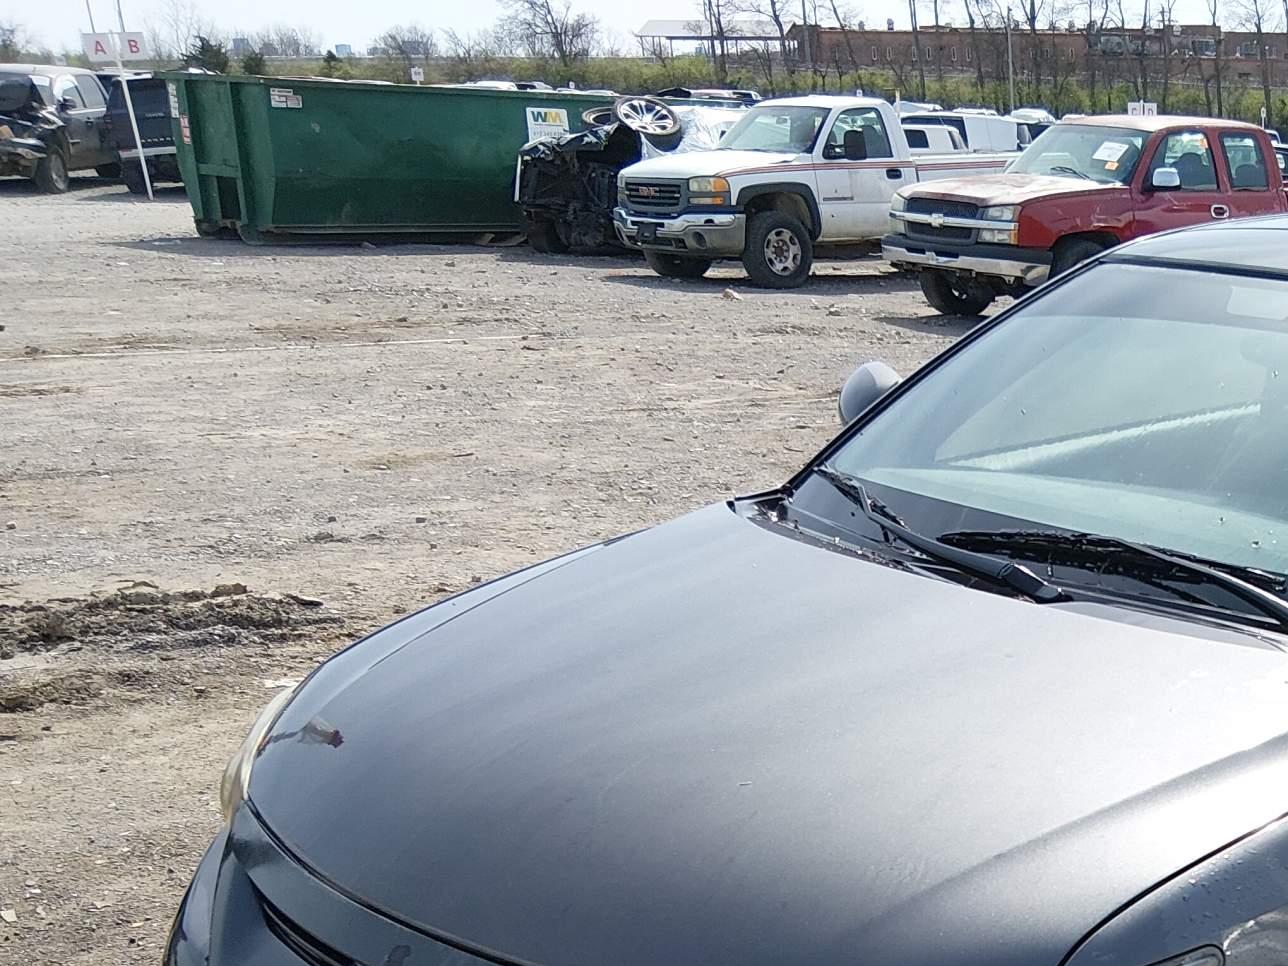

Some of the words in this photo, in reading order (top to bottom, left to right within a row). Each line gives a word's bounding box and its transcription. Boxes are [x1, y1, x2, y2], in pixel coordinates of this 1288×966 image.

[94, 41, 107, 54] A
[128, 40, 140, 53] B
[530, 111, 562, 123] WM
